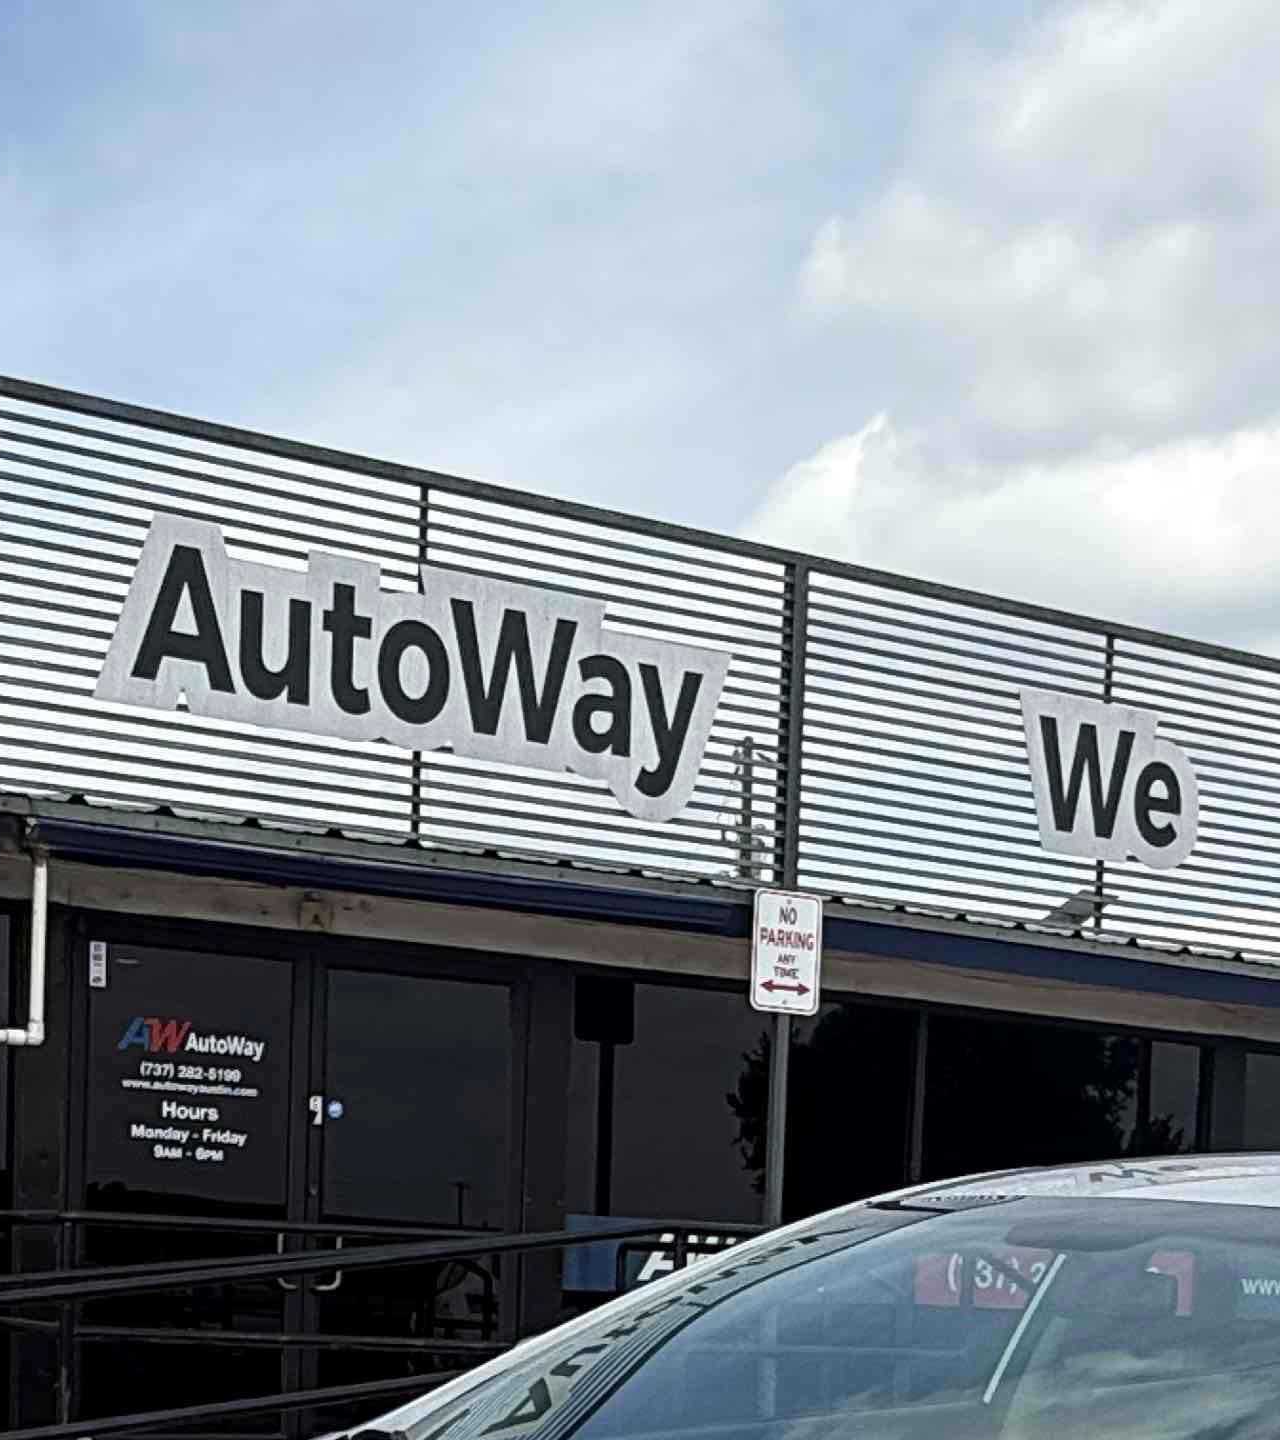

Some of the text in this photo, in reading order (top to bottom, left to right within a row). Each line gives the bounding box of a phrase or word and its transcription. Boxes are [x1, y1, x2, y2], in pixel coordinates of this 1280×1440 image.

[130, 544, 703, 798] AutoWay
[1039, 716, 1182, 849] We
[779, 906, 798, 925] NO
[760, 926, 814, 951] PARKING
[776, 953, 796, 963] ANY
[773, 965, 800, 979] TIME
[117, 1017, 265, 1061] AW AutoWay
[139, 1061, 175, 1078] (737)
[161, 1101, 219, 1121] Hours
[131, 1124, 190, 1143] Monday
[202, 1128, 247, 1147] Friday
[153, 1144, 183, 1159] 9AM
